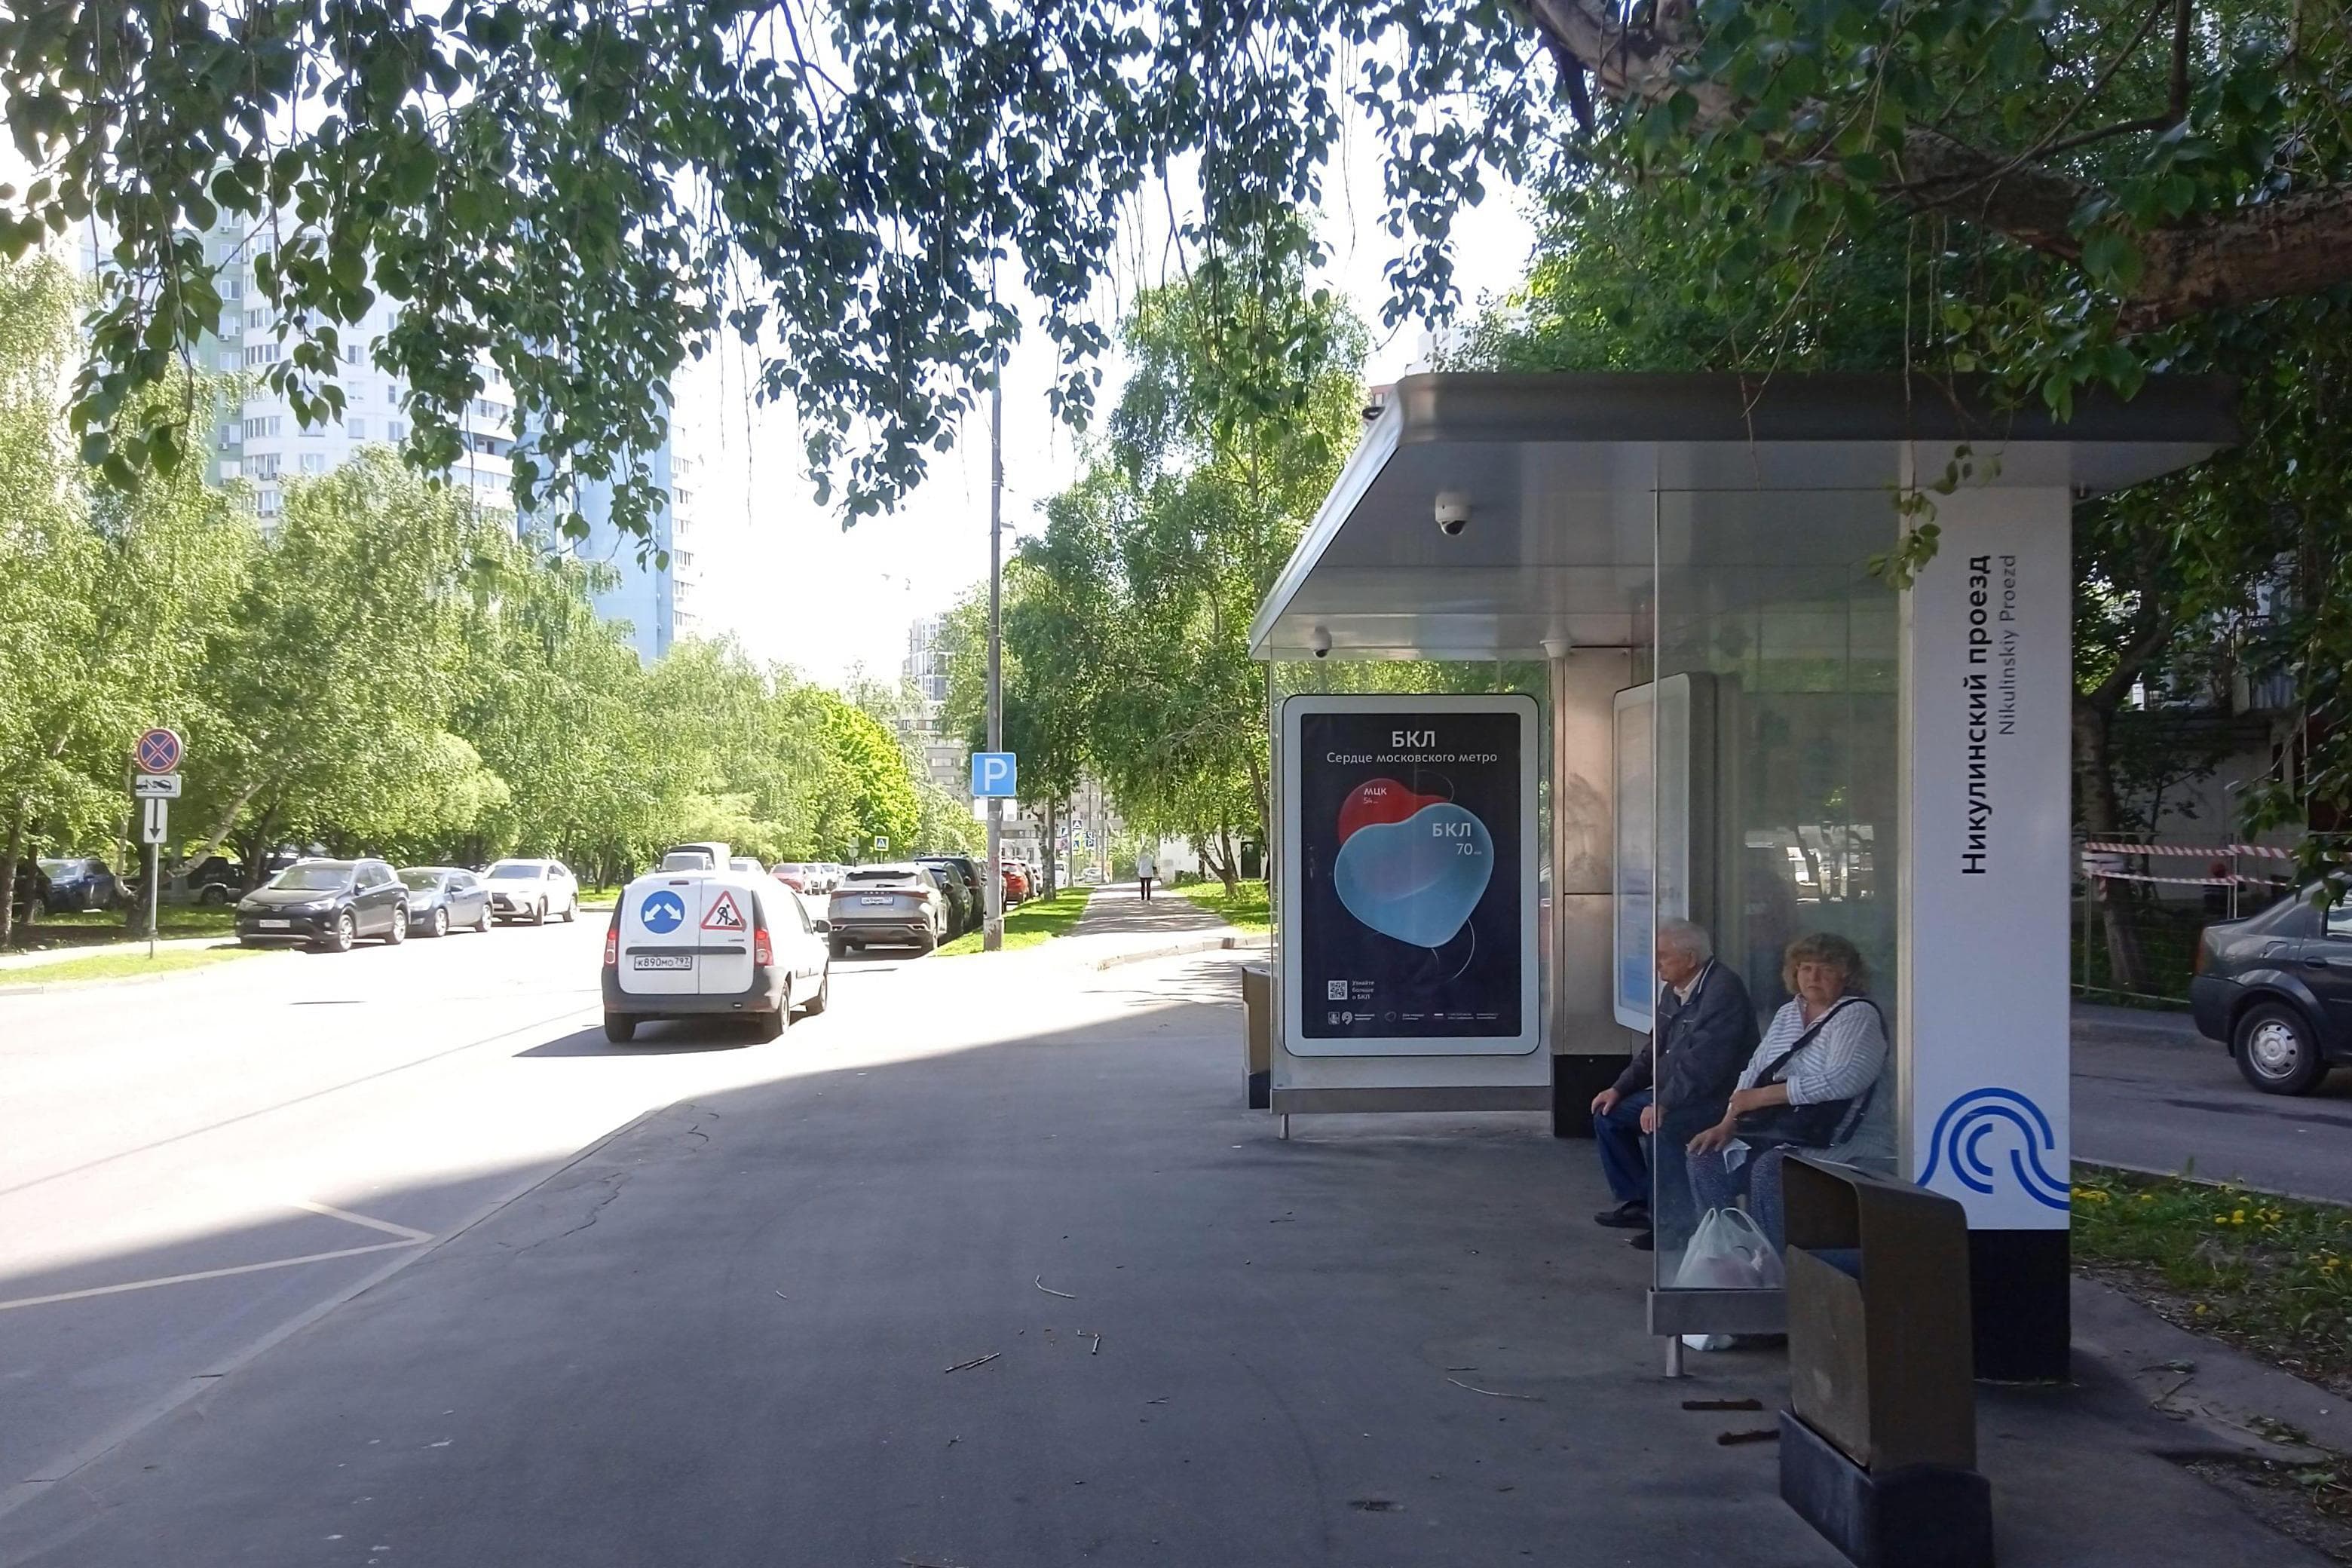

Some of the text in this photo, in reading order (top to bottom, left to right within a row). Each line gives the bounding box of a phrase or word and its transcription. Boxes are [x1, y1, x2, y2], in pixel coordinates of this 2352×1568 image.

[1999, 555, 2020, 736] Nikulinskiy Proezd
[1962, 555, 1992, 874] Никулинский проезд
[1392, 730, 1435, 748] БКЛ
[1327, 752, 1498, 764] Сердце московского метро
[985, 758, 1008, 792] P
[1432, 822, 1471, 837] БКЛ
[1456, 843, 1473, 856] 70
